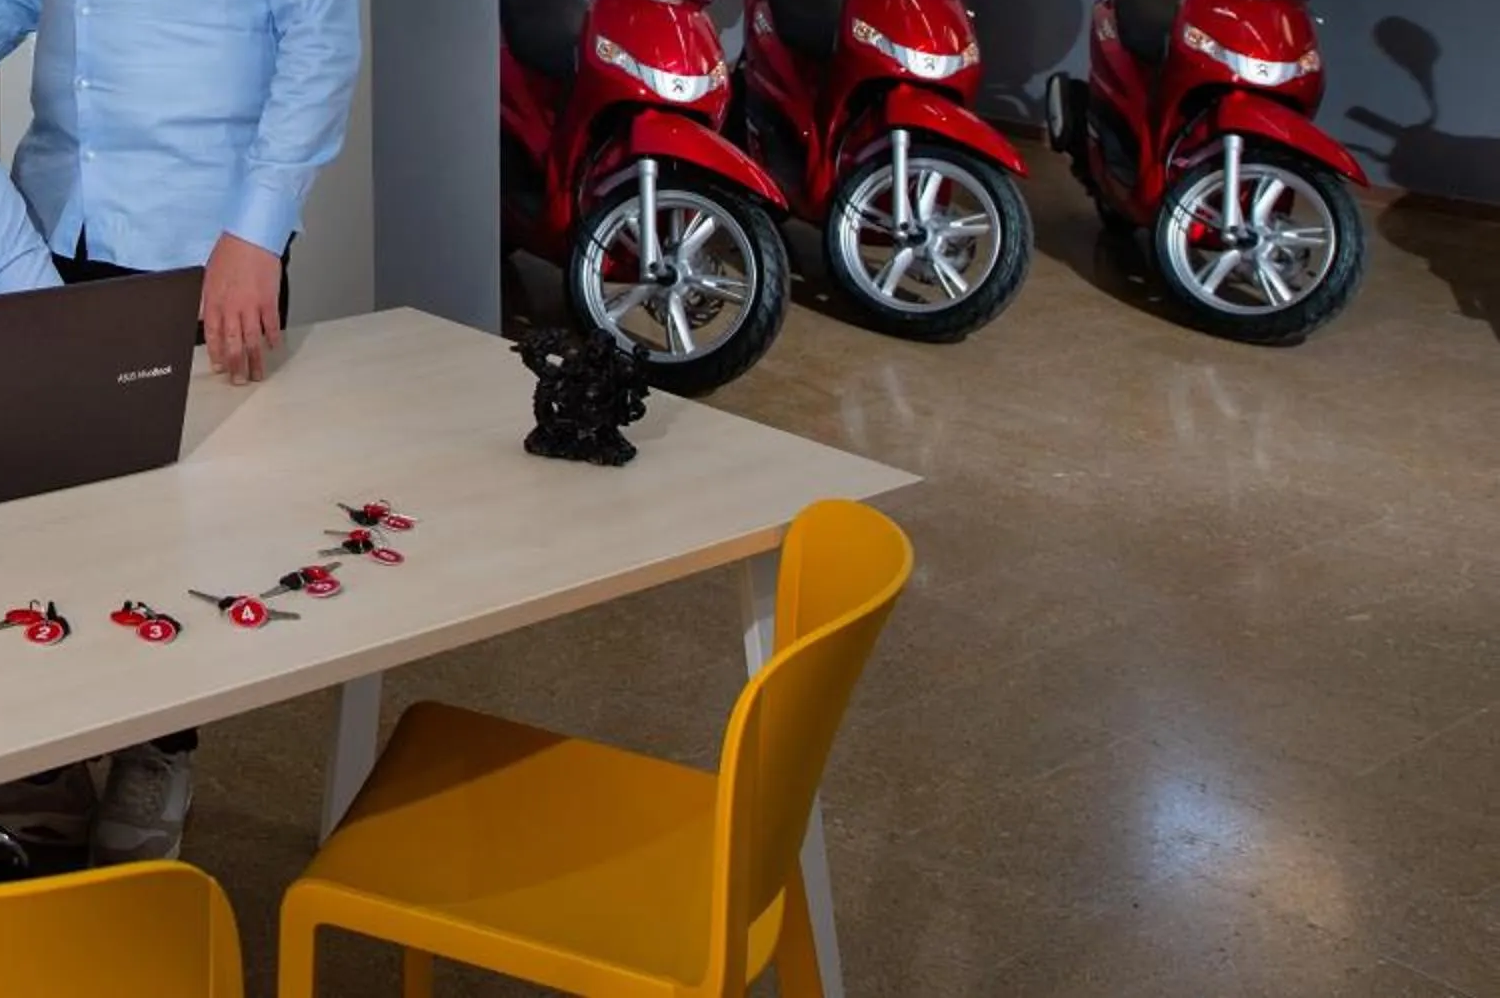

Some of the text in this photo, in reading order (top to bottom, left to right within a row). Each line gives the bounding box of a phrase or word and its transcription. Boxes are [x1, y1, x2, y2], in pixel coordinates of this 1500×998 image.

[241, 604, 255, 620] 4
[35, 626, 51, 639] 2
[150, 625, 163, 639] 3
